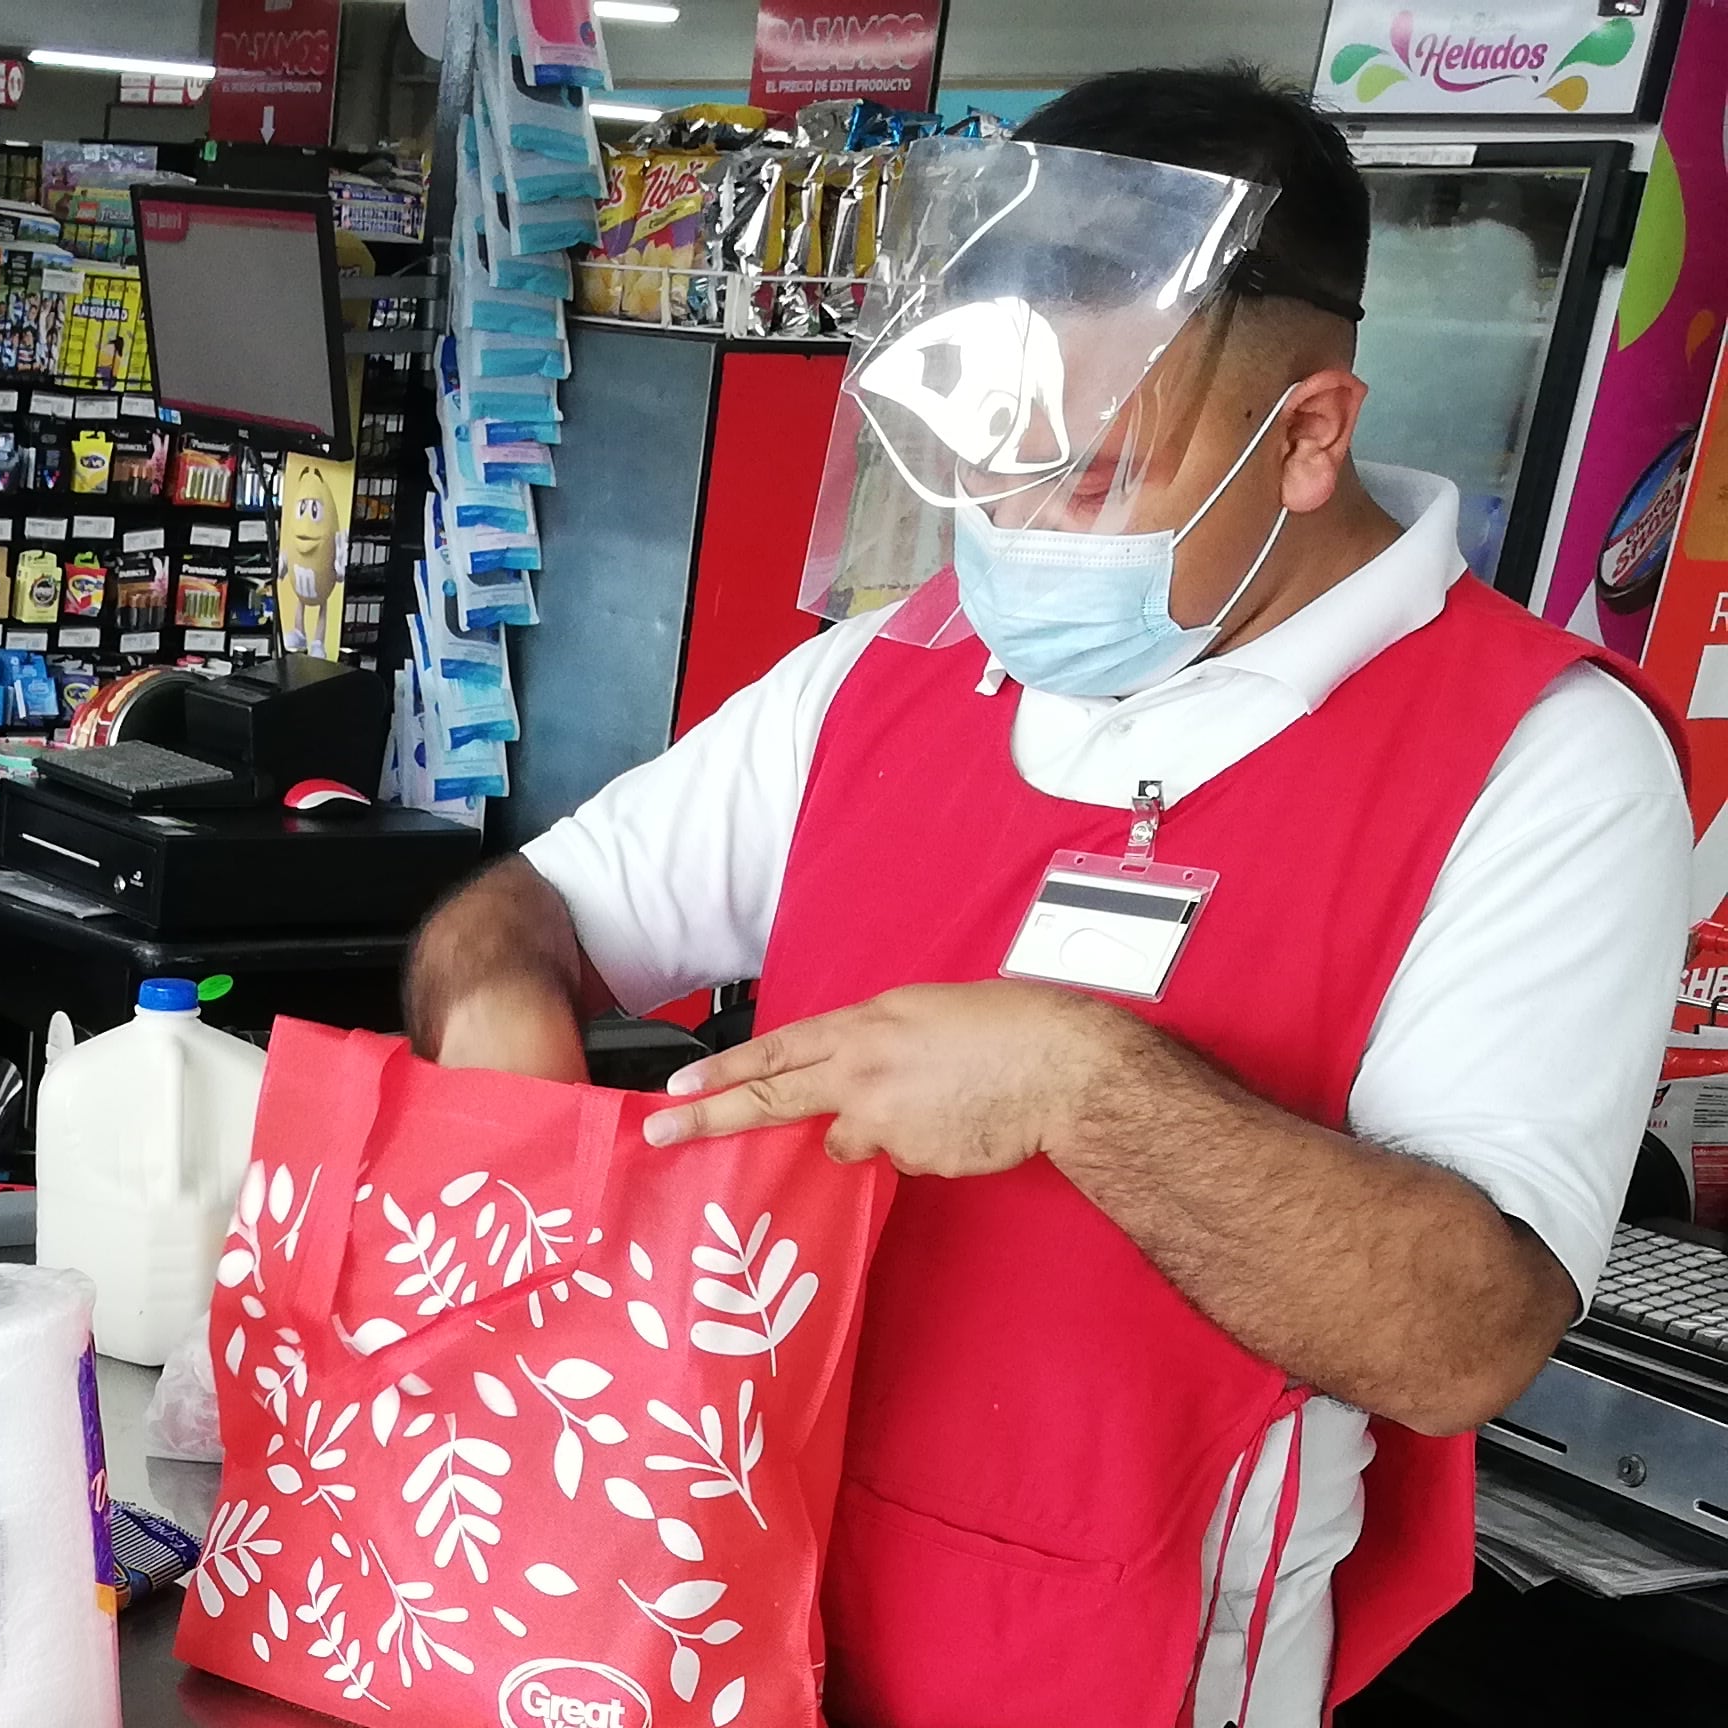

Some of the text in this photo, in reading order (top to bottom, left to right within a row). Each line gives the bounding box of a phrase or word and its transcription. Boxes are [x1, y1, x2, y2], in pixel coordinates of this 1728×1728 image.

[1415, 33, 1548, 82] Helados
[766, 78, 912, 93] EL PRECIO DE ESTE PRODUCTO
[182, 564, 227, 576] Panasonic
